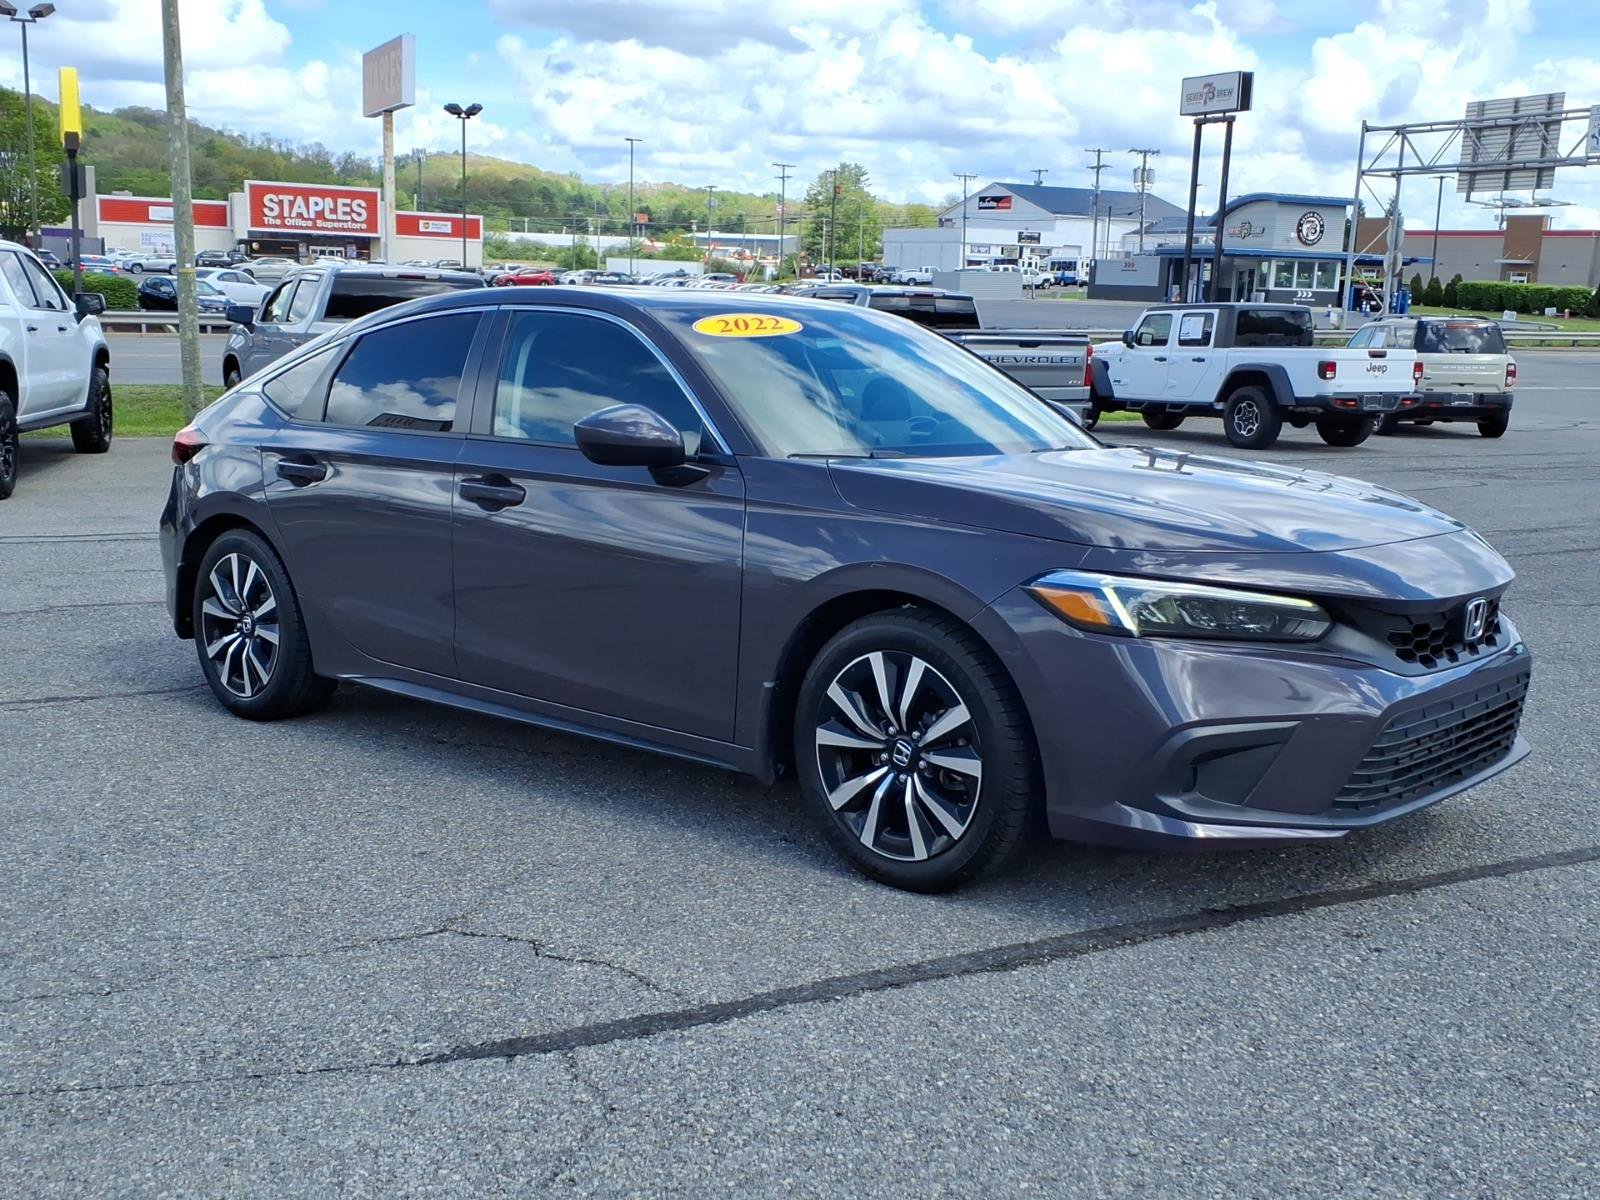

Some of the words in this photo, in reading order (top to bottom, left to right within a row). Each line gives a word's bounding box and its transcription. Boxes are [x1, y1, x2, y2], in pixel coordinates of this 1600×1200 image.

[263, 194, 367, 222] STAPLES
[263, 217, 281, 226] The
[285, 218, 313, 228] Office
[316, 220, 367, 231] Superstore
[716, 317, 784, 333] 2022
[1366, 362, 1388, 375] Jeep
